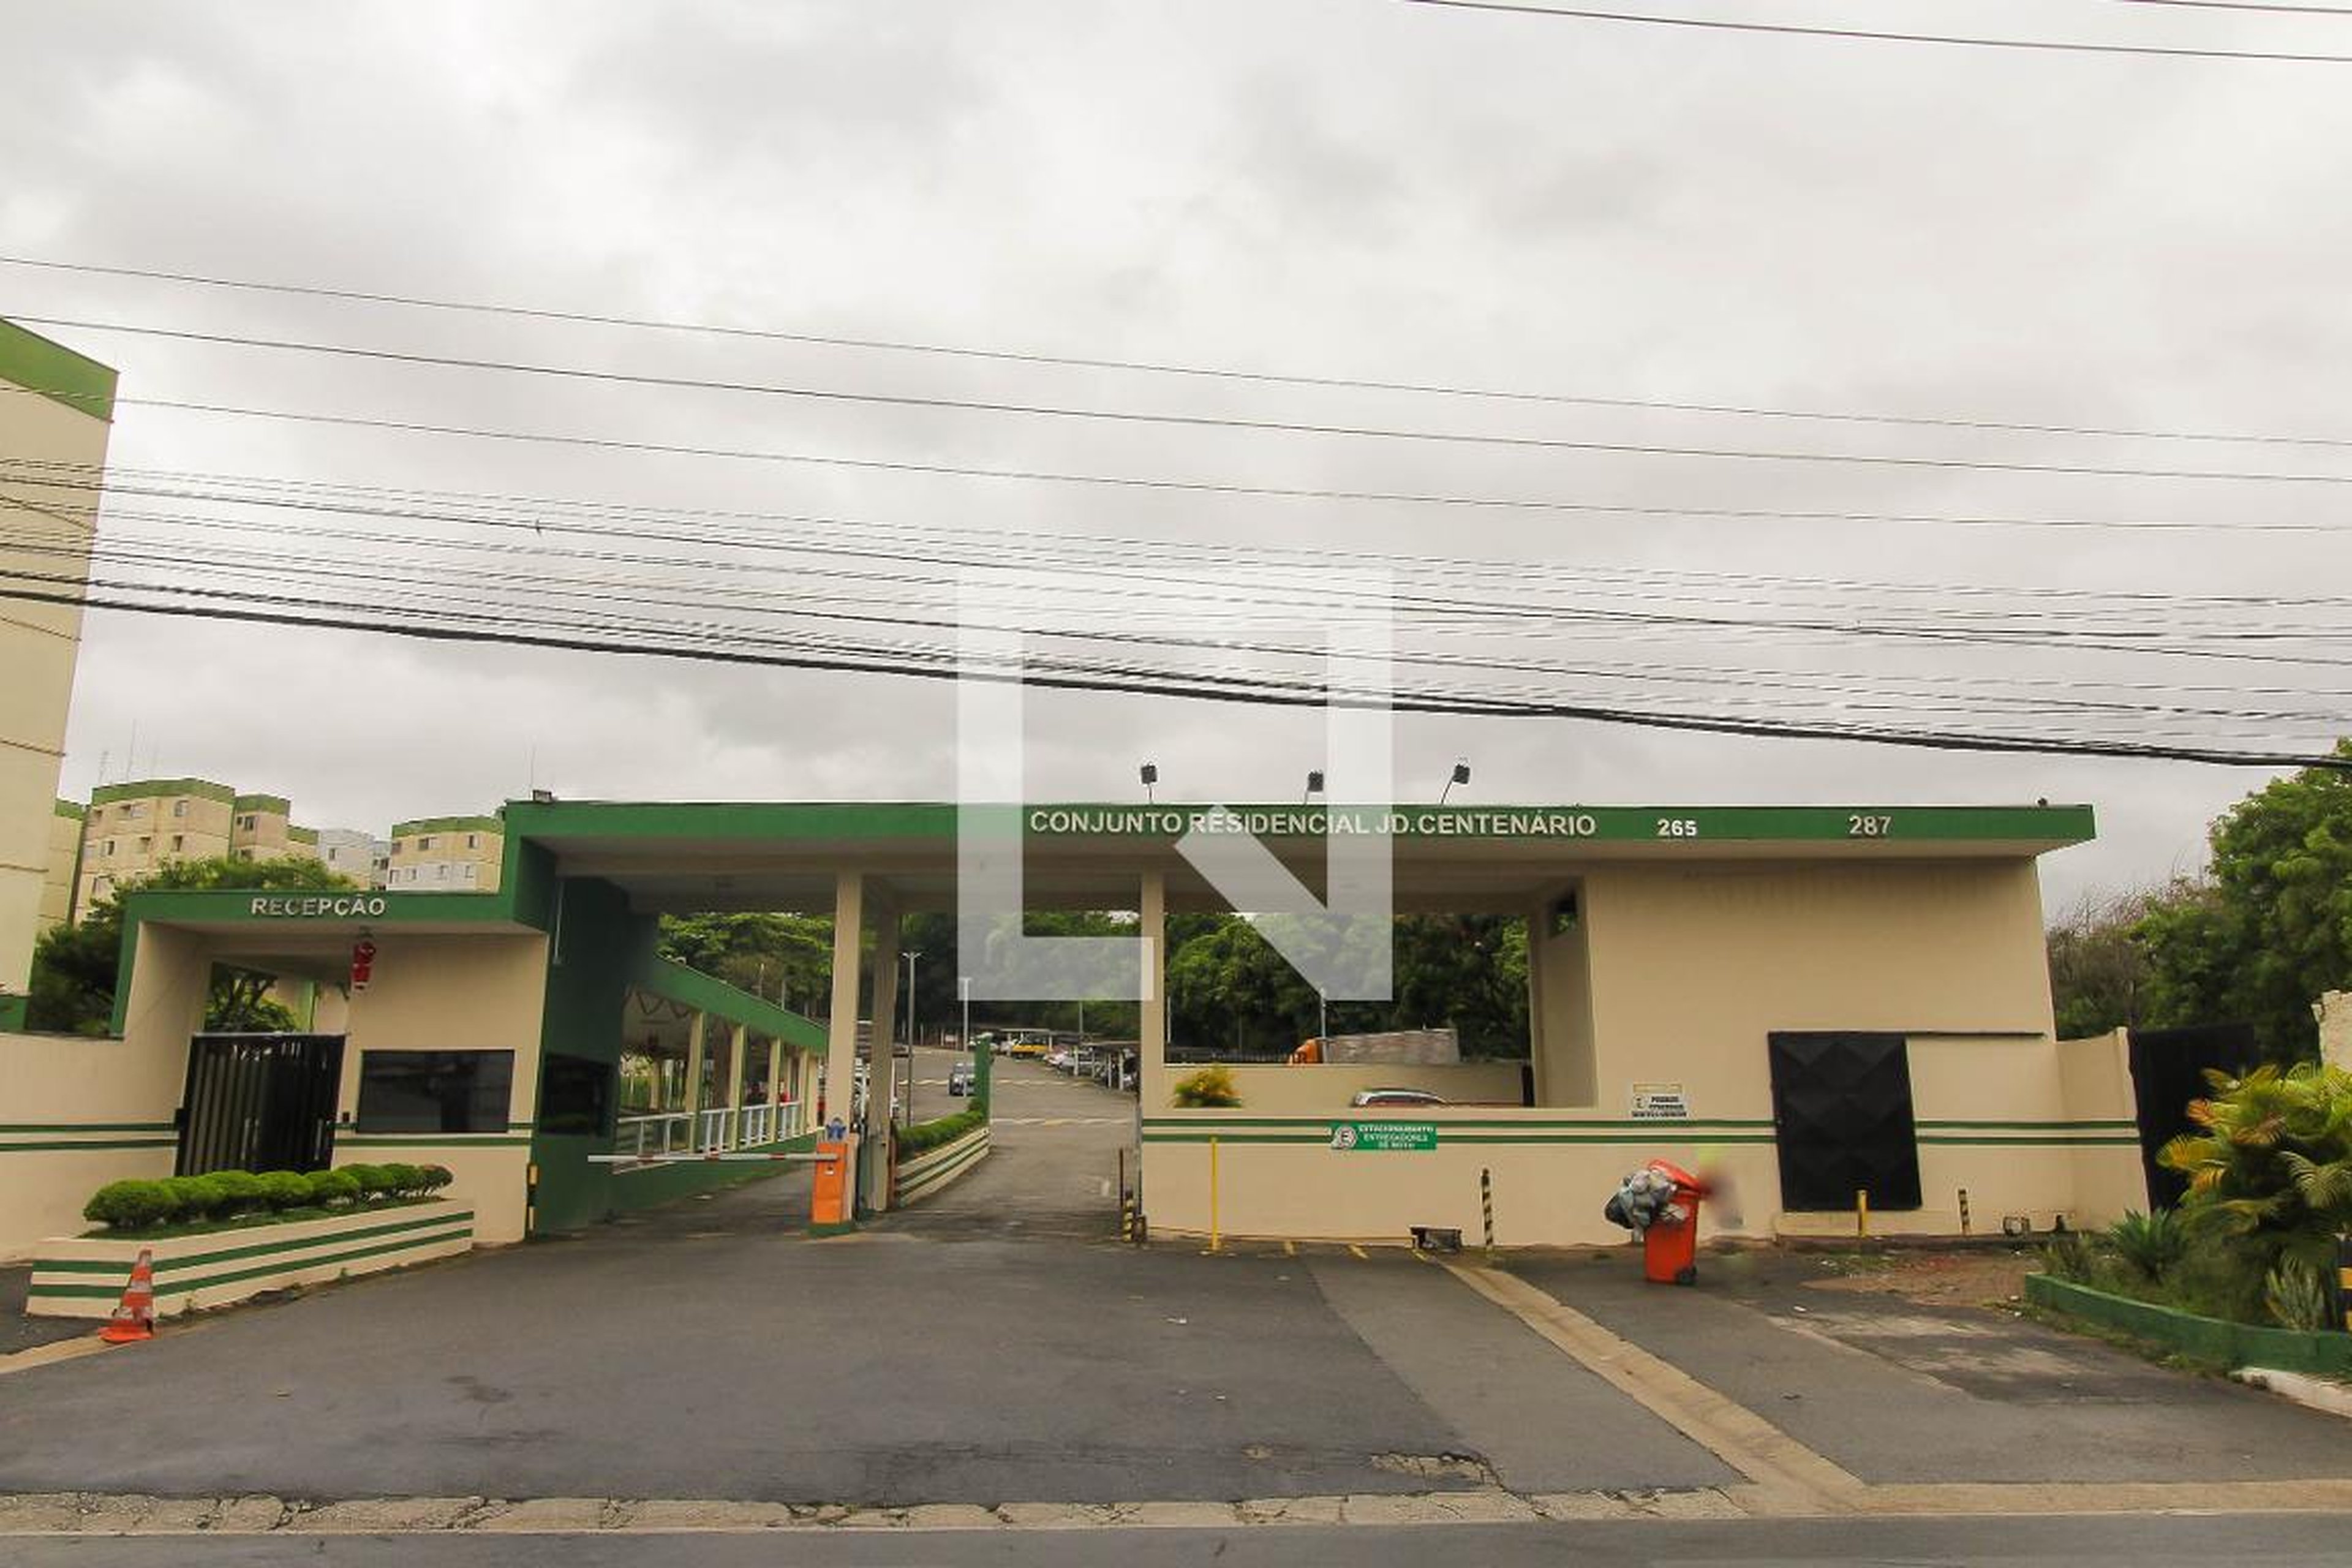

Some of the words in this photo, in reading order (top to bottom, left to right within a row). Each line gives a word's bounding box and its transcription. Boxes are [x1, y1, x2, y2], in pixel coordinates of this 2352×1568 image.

[1030, 811, 1182, 833] CONJUNTO
[1188, 813, 1370, 834] RESIDENCIAL
[1657, 818, 1698, 837] 265
[1849, 815, 1892, 835] 287
